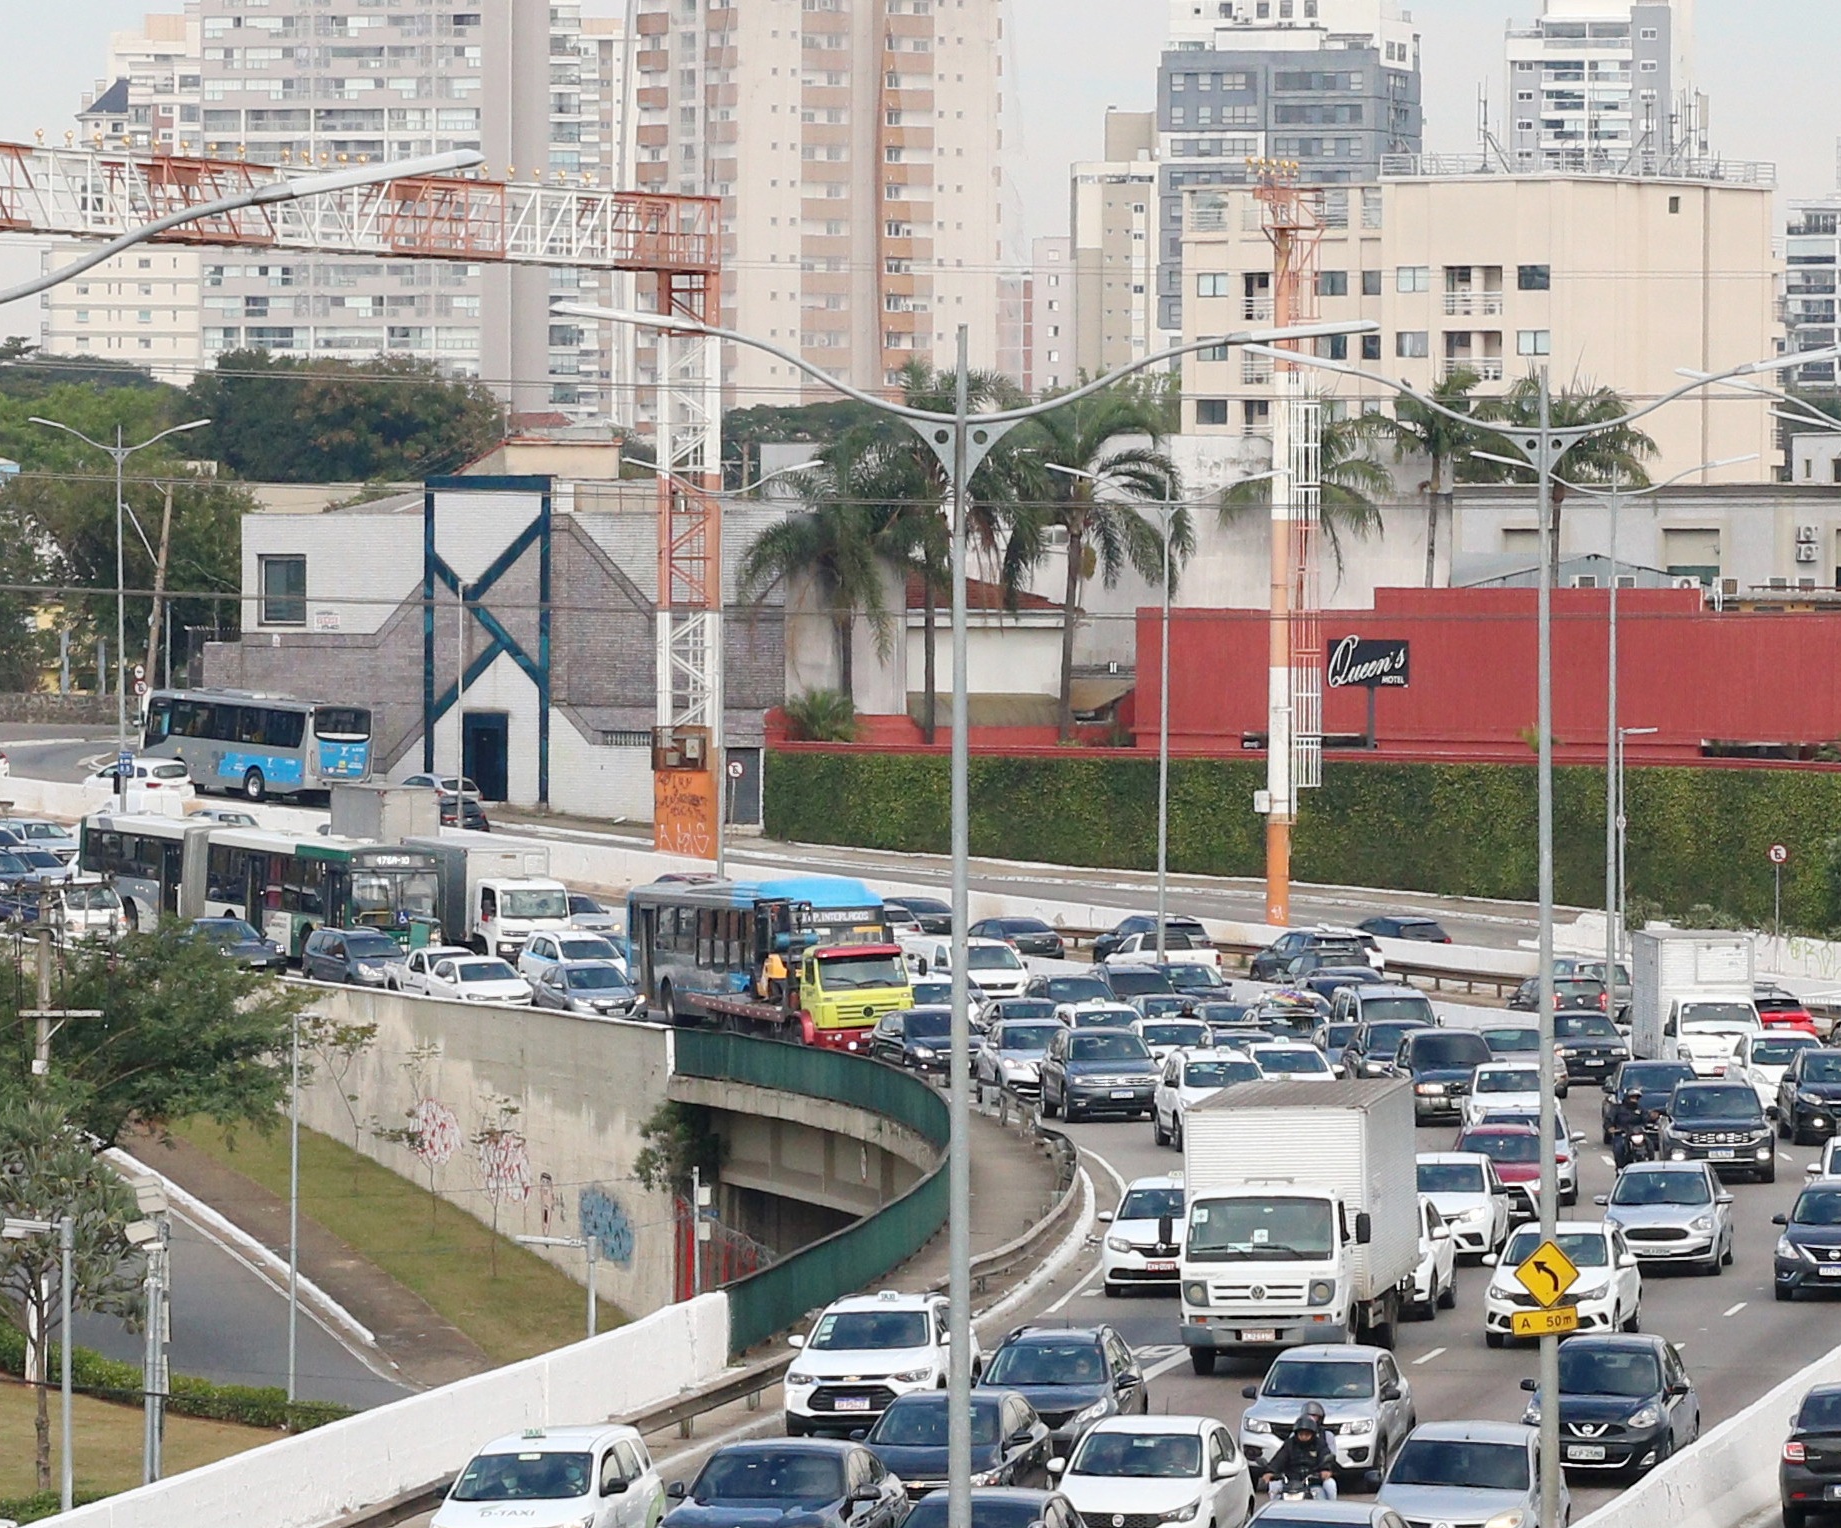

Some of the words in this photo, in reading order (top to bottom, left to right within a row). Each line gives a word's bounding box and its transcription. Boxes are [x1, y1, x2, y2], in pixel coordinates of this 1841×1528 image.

[1328, 634, 1405, 688] Queen's
[1381, 676, 1405, 685] MOTEL
[1521, 1318, 1531, 1330] A
[524, 1429, 543, 1437] TAXI
[480, 1509, 536, 1518] D-TAXI
